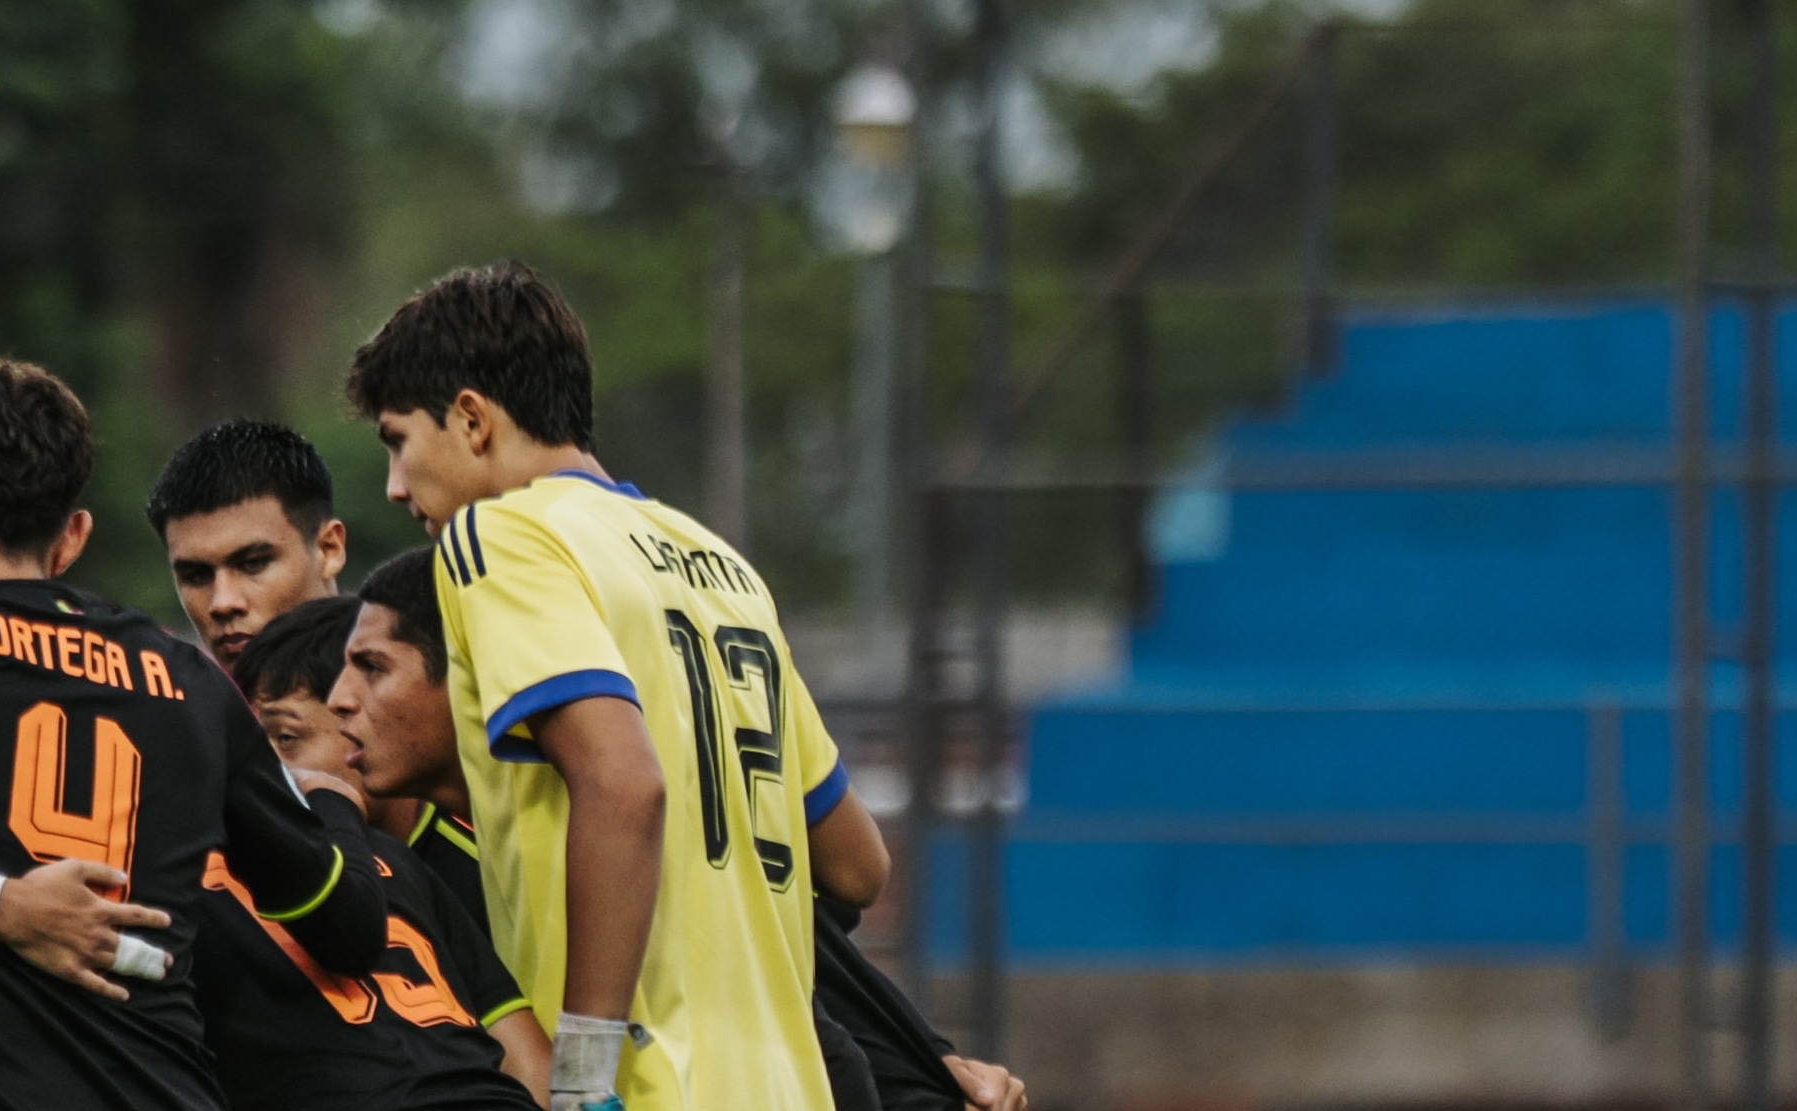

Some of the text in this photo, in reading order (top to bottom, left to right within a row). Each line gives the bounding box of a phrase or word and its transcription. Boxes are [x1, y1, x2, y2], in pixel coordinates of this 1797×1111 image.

[140, 650, 185, 701] A.
[663, 608, 795, 894] 12
[7, 701, 142, 904] 4
